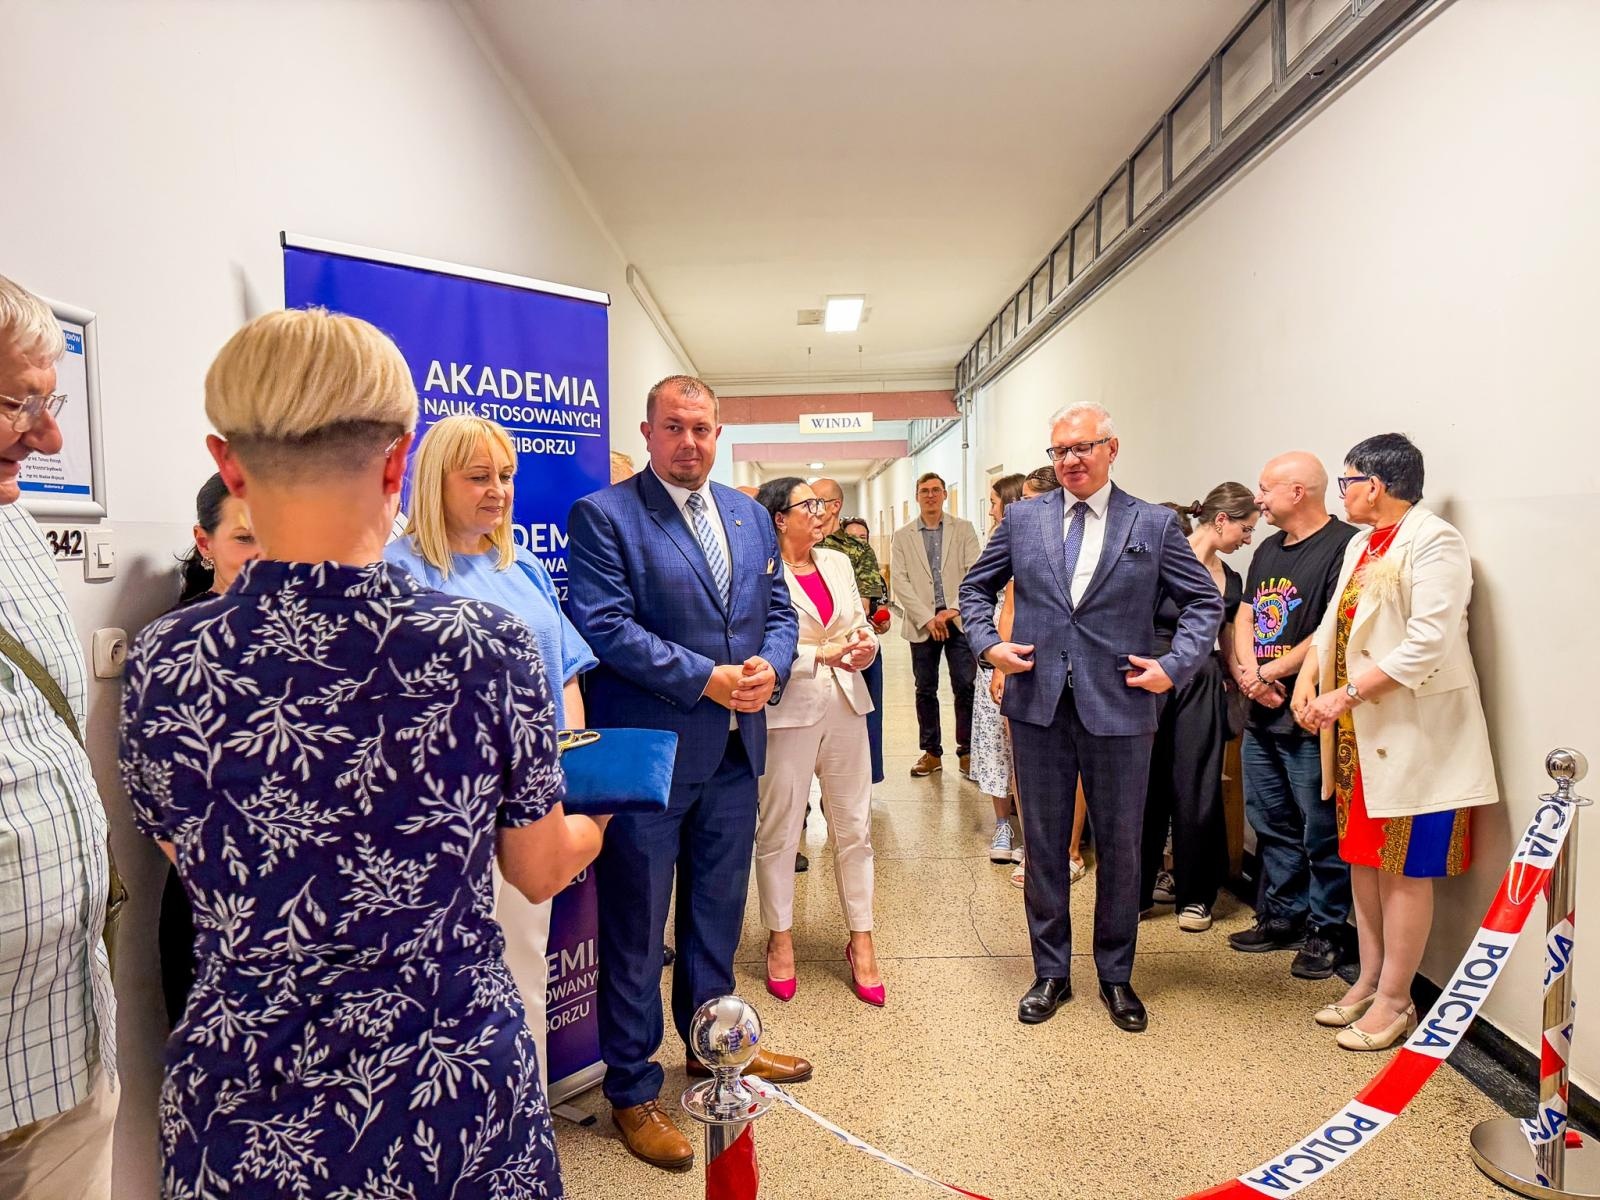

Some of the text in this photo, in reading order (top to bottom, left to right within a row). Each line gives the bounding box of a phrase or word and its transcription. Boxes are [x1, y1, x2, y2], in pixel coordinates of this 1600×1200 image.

[424, 360, 600, 408] AKADEMIA
[424, 398, 601, 429] NAUK STOSOWANYCH
[811, 416, 862, 429] WINDA
[46, 530, 83, 556] 342
[1412, 942, 1509, 1050] POLICJA
[1247, 1112, 1380, 1191] POLICJA
